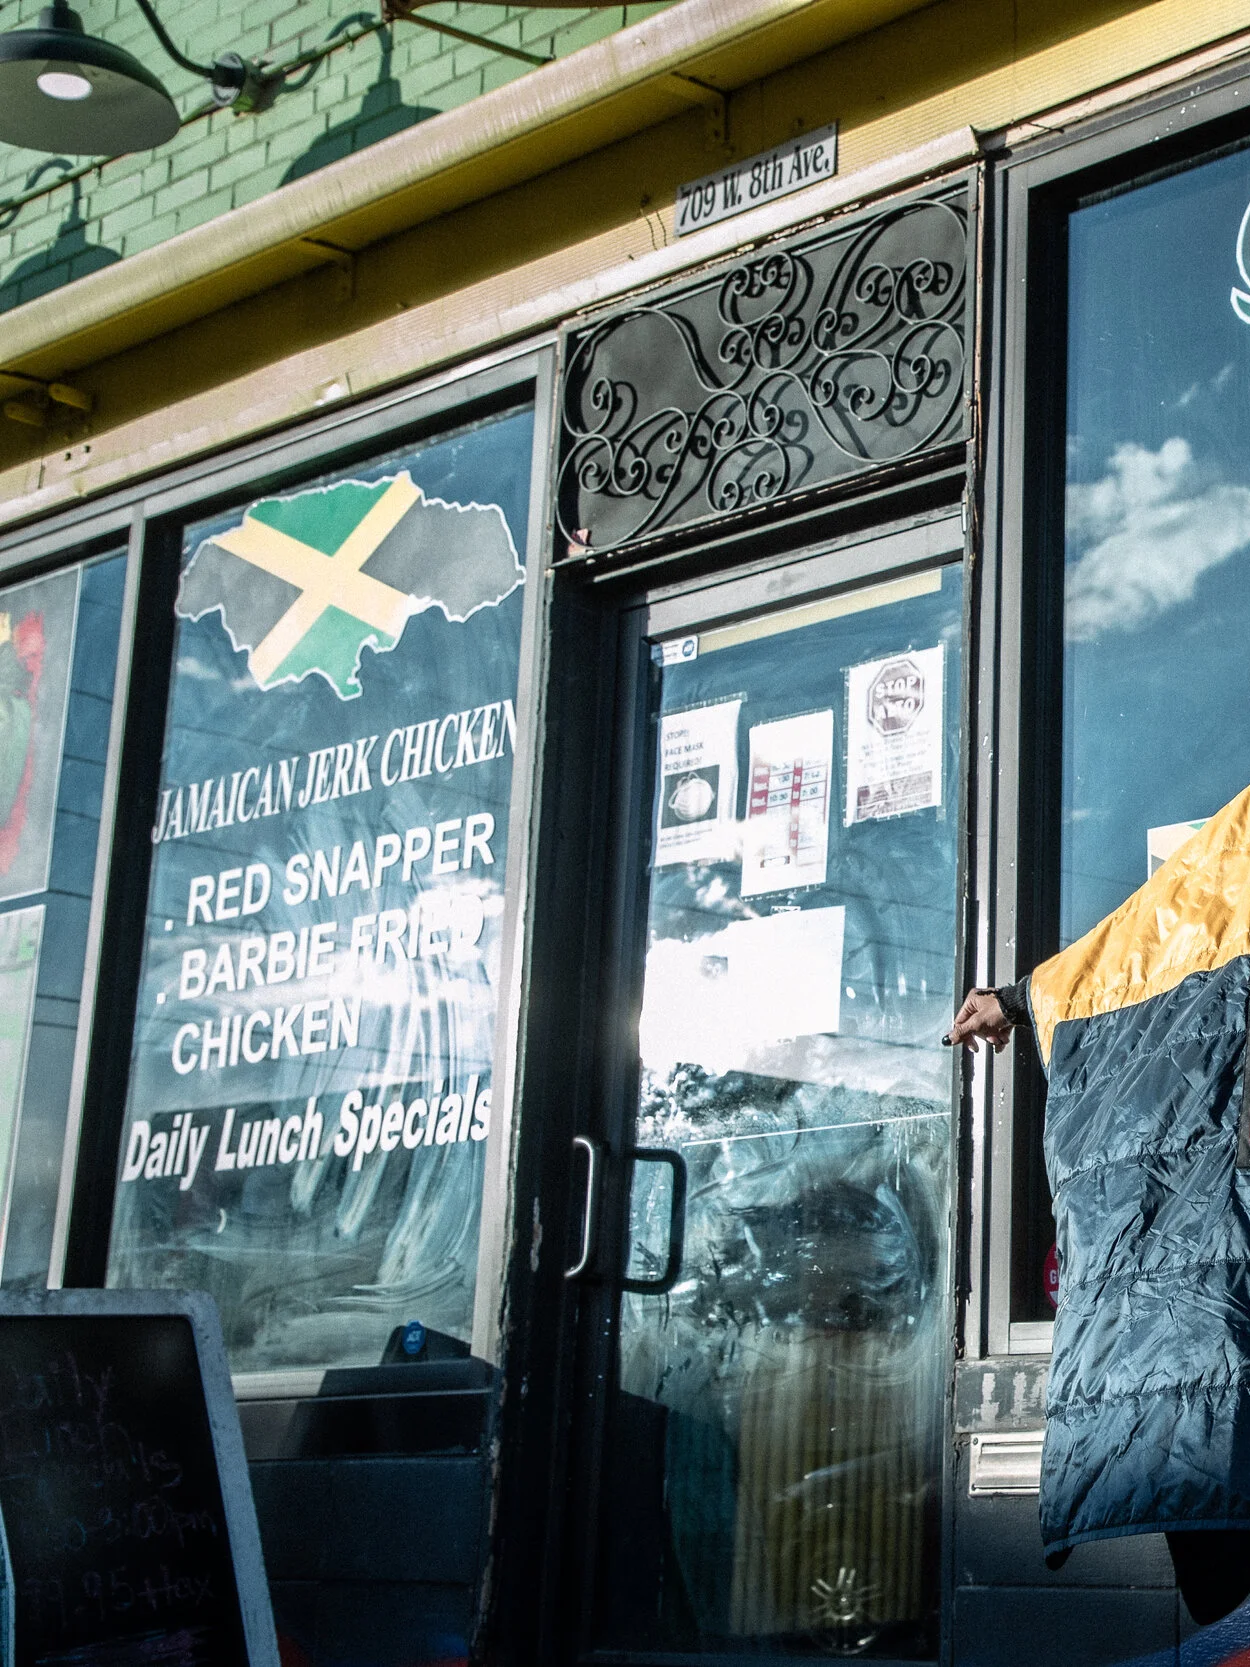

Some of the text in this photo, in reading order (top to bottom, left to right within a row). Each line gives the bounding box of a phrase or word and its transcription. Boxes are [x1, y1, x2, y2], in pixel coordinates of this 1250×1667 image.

[680, 180, 716, 226] 709
[723, 169, 742, 209] W.
[750, 153, 783, 198] 8th
[875, 676, 917, 698] STOP
[152, 699, 517, 844] JAMAICAN JERK CHICKEN
[186, 812, 496, 927] RED SNAPPER
[178, 921, 337, 1001] BARBIE
[171, 996, 363, 1075] CHICKEN
[121, 1073, 492, 1190] Daily Lunch Specials
